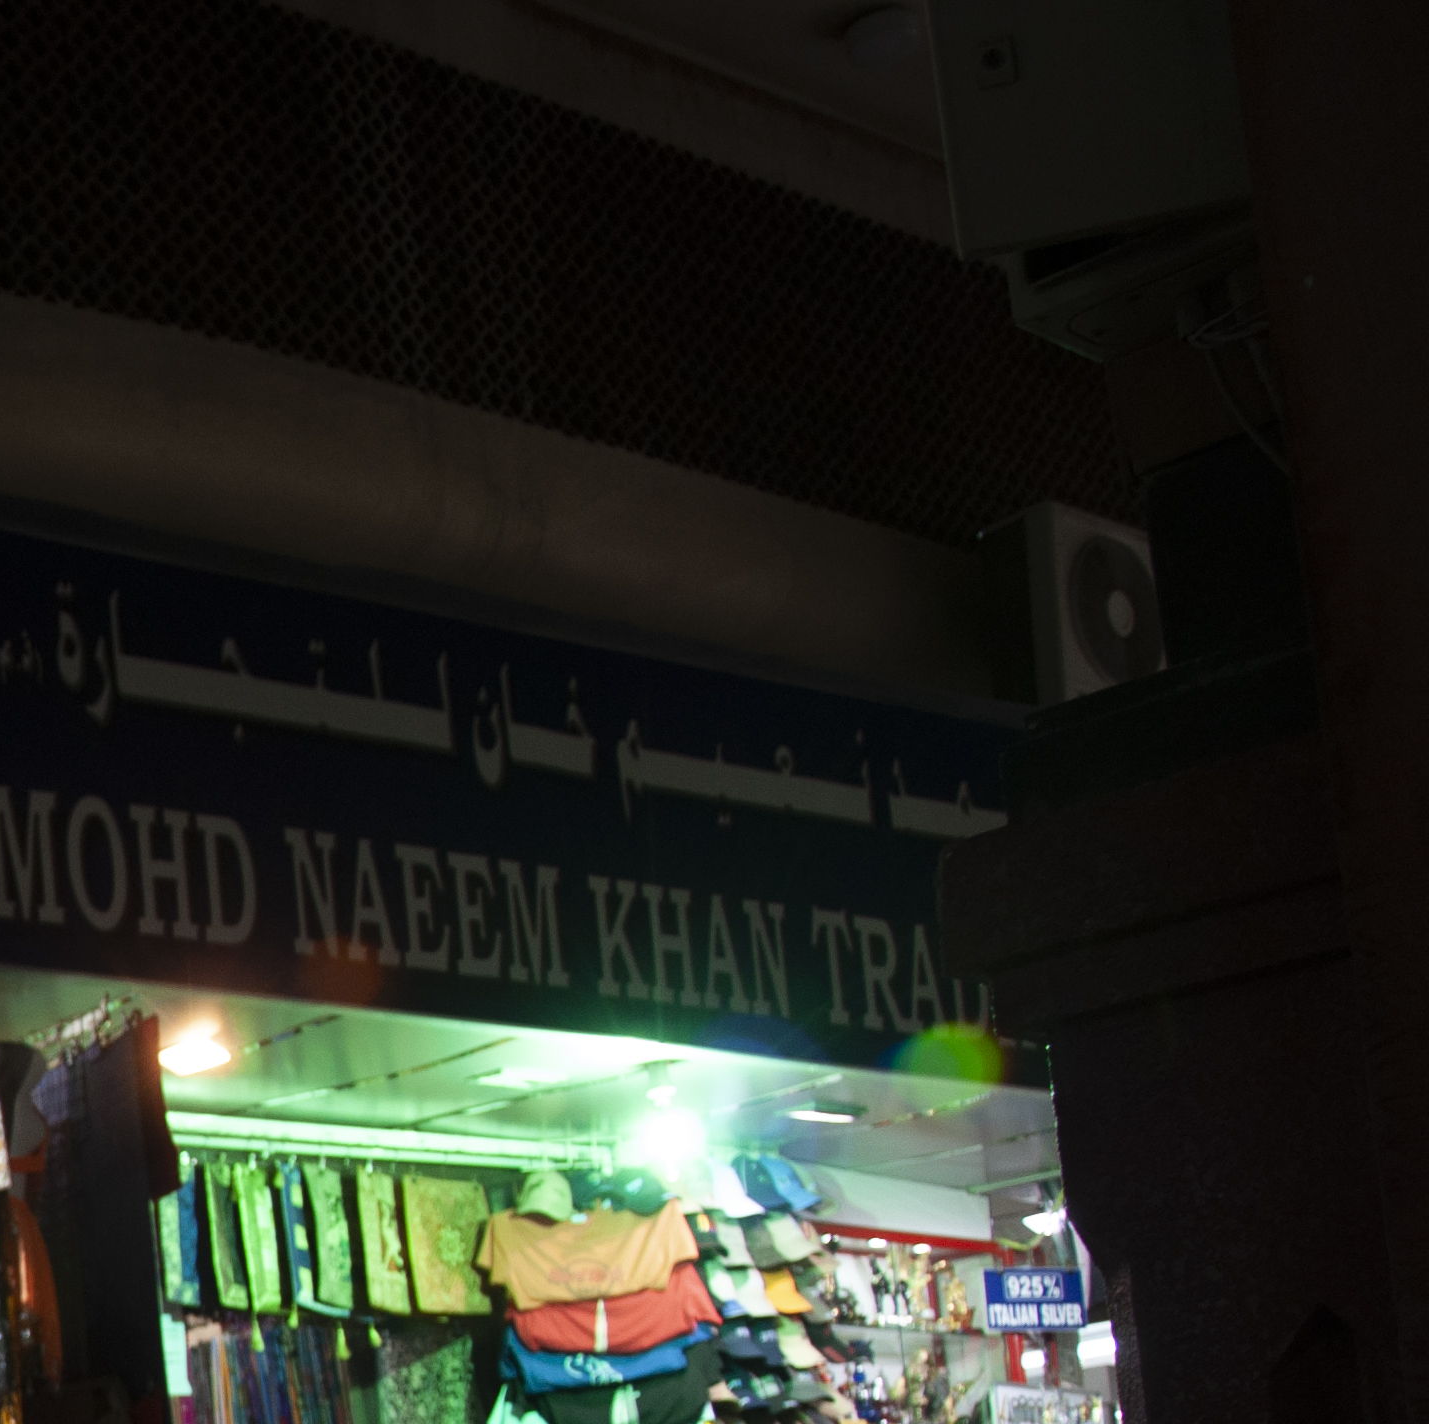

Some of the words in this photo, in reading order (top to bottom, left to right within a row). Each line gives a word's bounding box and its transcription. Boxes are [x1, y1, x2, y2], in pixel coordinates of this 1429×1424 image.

[54, 580, 458, 757] للتجارة
[471, 660, 598, 791] خان
[615, 717, 878, 827] نعيم
[283, 826, 571, 988] NAEEM
[588, 873, 791, 1020] KHAN
[989, 1302, 1039, 1327] ITALIAN
[1041, 1302, 1084, 1327] SILVER
[1006, 1275, 1061, 1299] 925%
